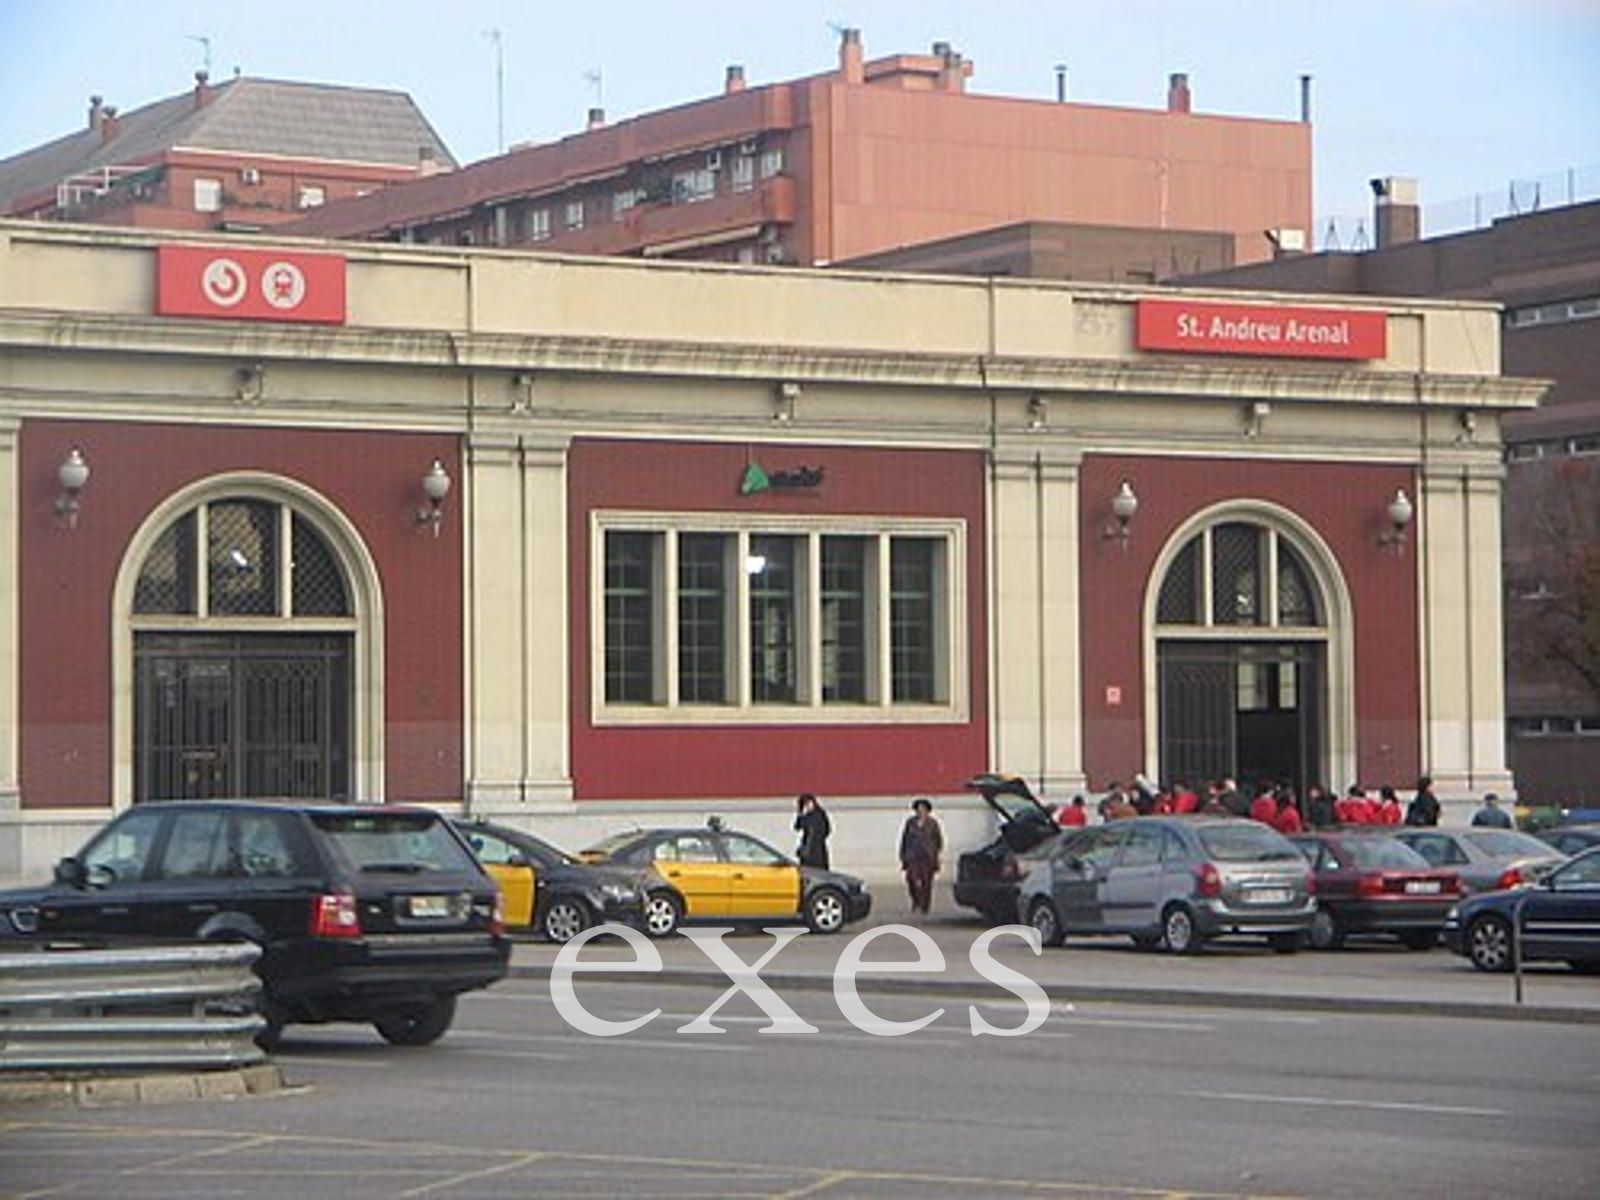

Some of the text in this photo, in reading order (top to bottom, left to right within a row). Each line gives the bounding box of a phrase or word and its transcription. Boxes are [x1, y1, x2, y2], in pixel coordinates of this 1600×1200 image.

[1176, 314, 1350, 344] St. Andreu Arenal
